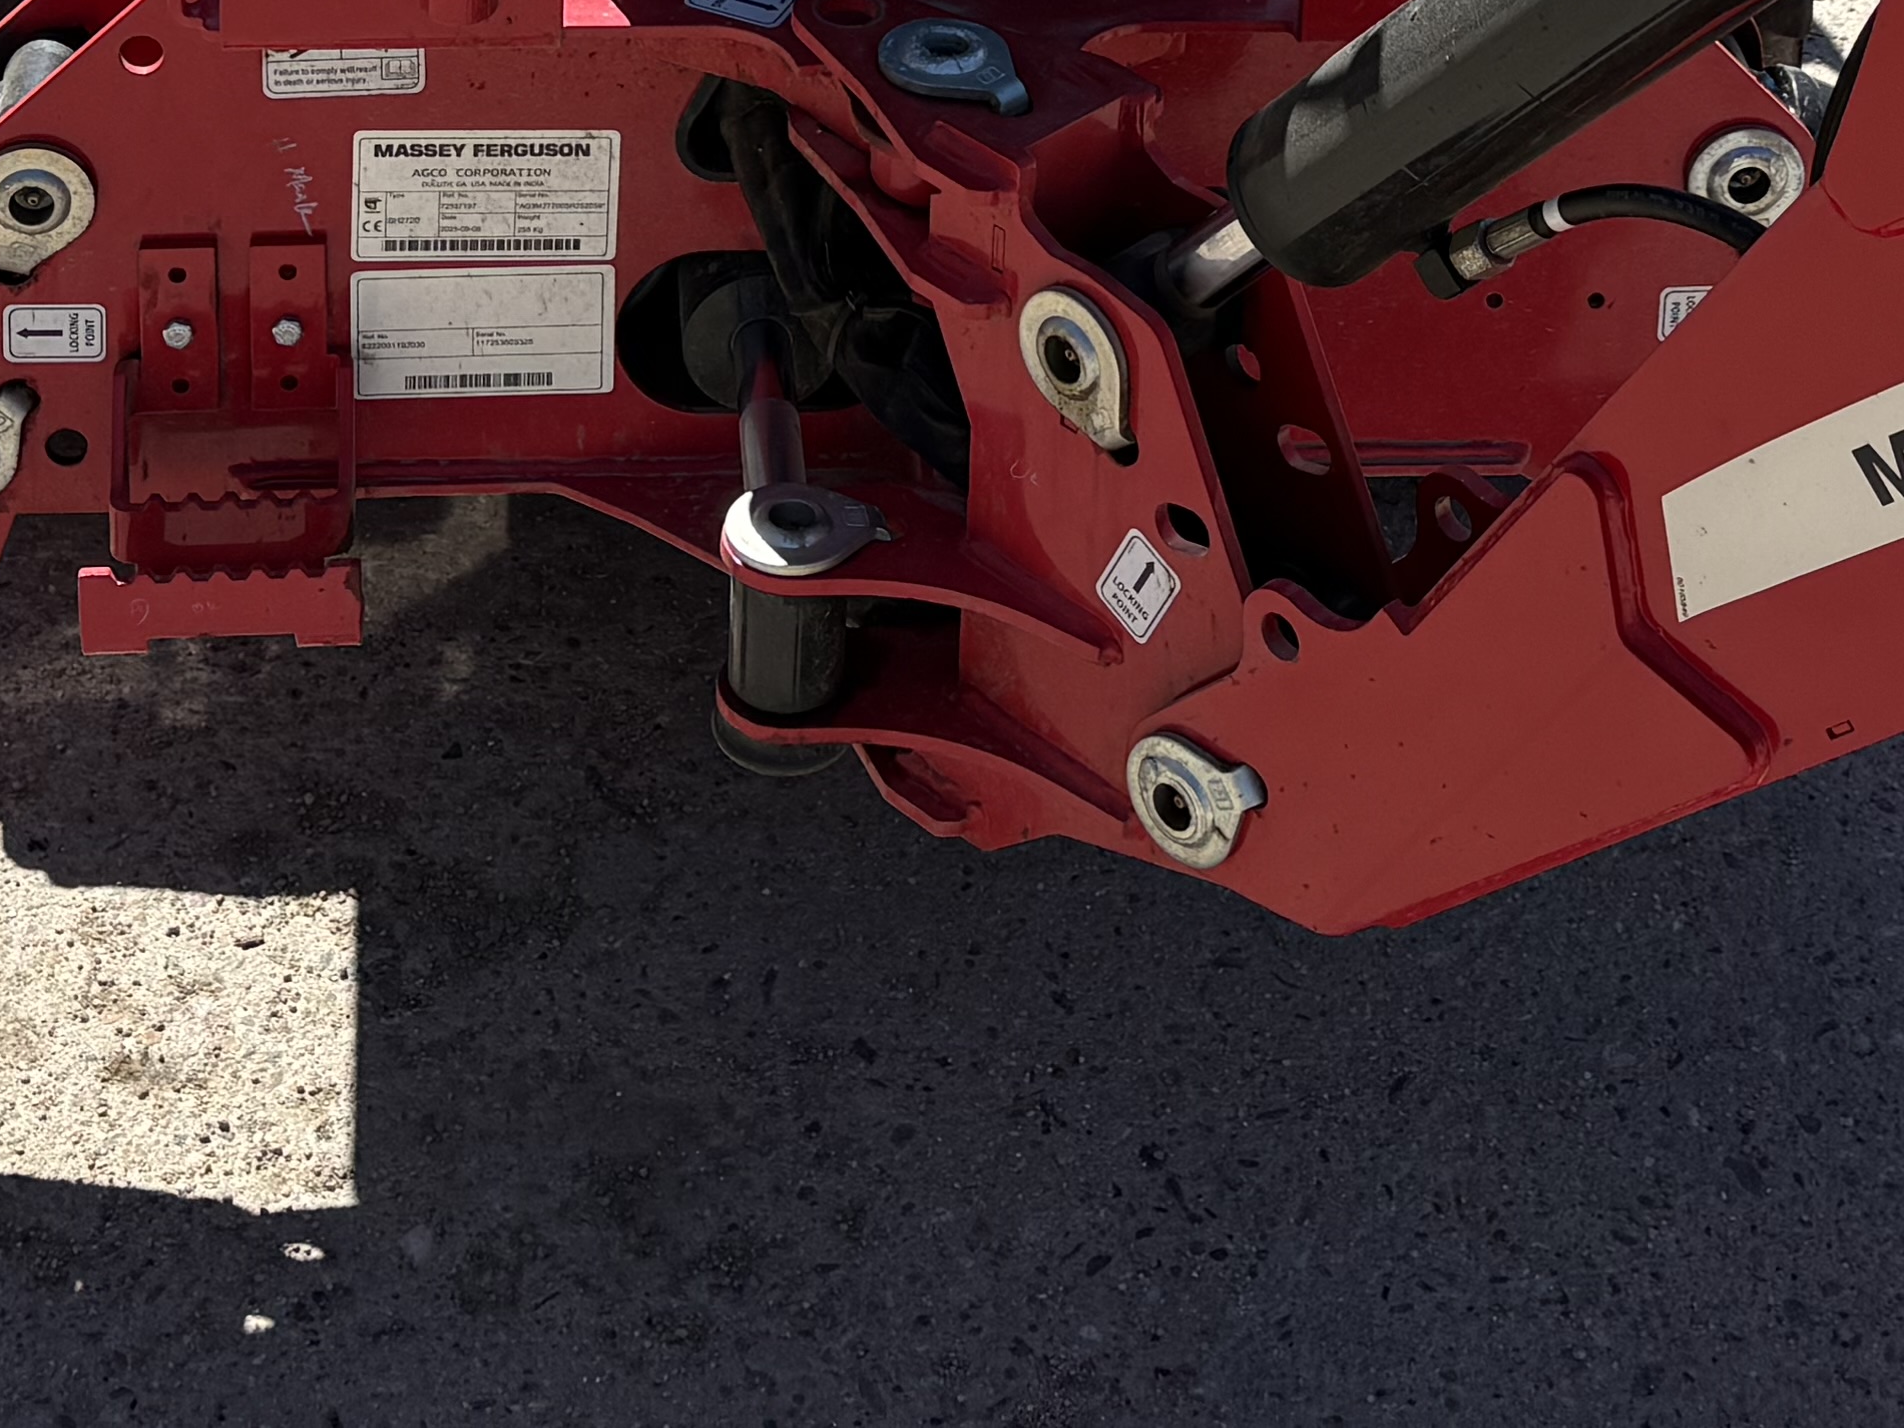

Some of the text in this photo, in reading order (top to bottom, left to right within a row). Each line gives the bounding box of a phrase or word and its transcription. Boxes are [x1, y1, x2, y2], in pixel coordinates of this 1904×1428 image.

[373, 143, 591, 158] MASSEY FERGUSON
[411, 167, 552, 178] AGCO CORPORATION
[1111, 593, 1139, 624] POINT
[1112, 575, 1150, 621] LOCKING
